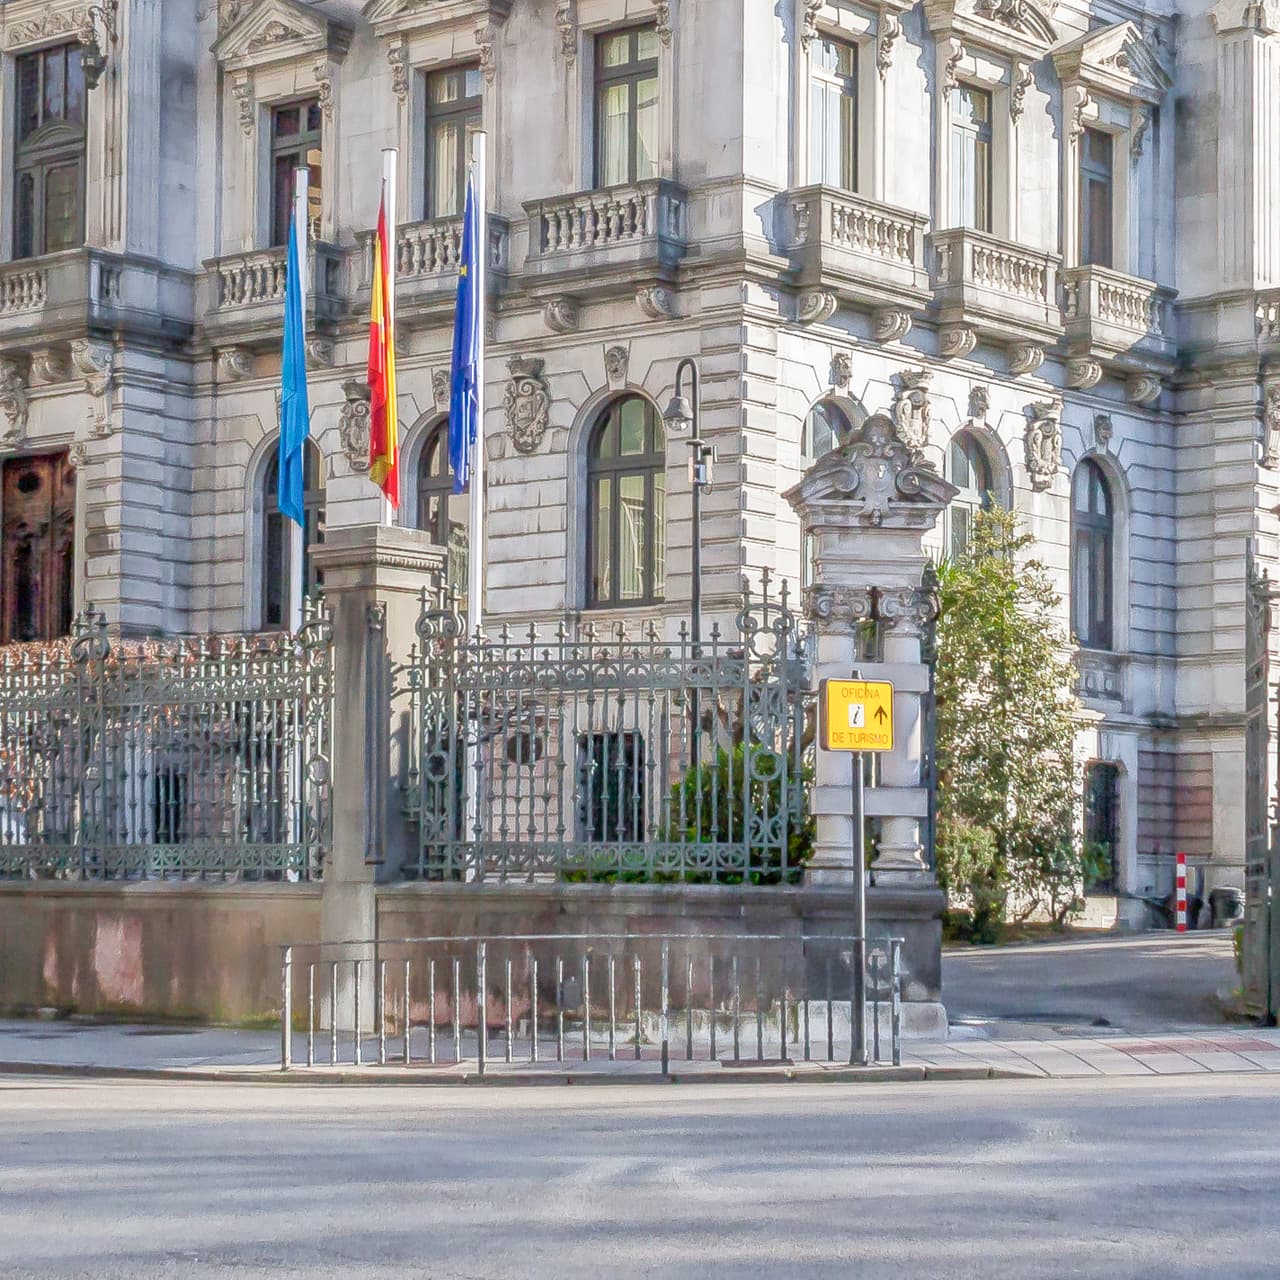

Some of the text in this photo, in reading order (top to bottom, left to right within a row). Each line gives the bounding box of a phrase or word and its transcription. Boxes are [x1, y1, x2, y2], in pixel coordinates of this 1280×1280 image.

[841, 687, 880, 699] OFICINA
[832, 731, 888, 745] DE TURISMO
